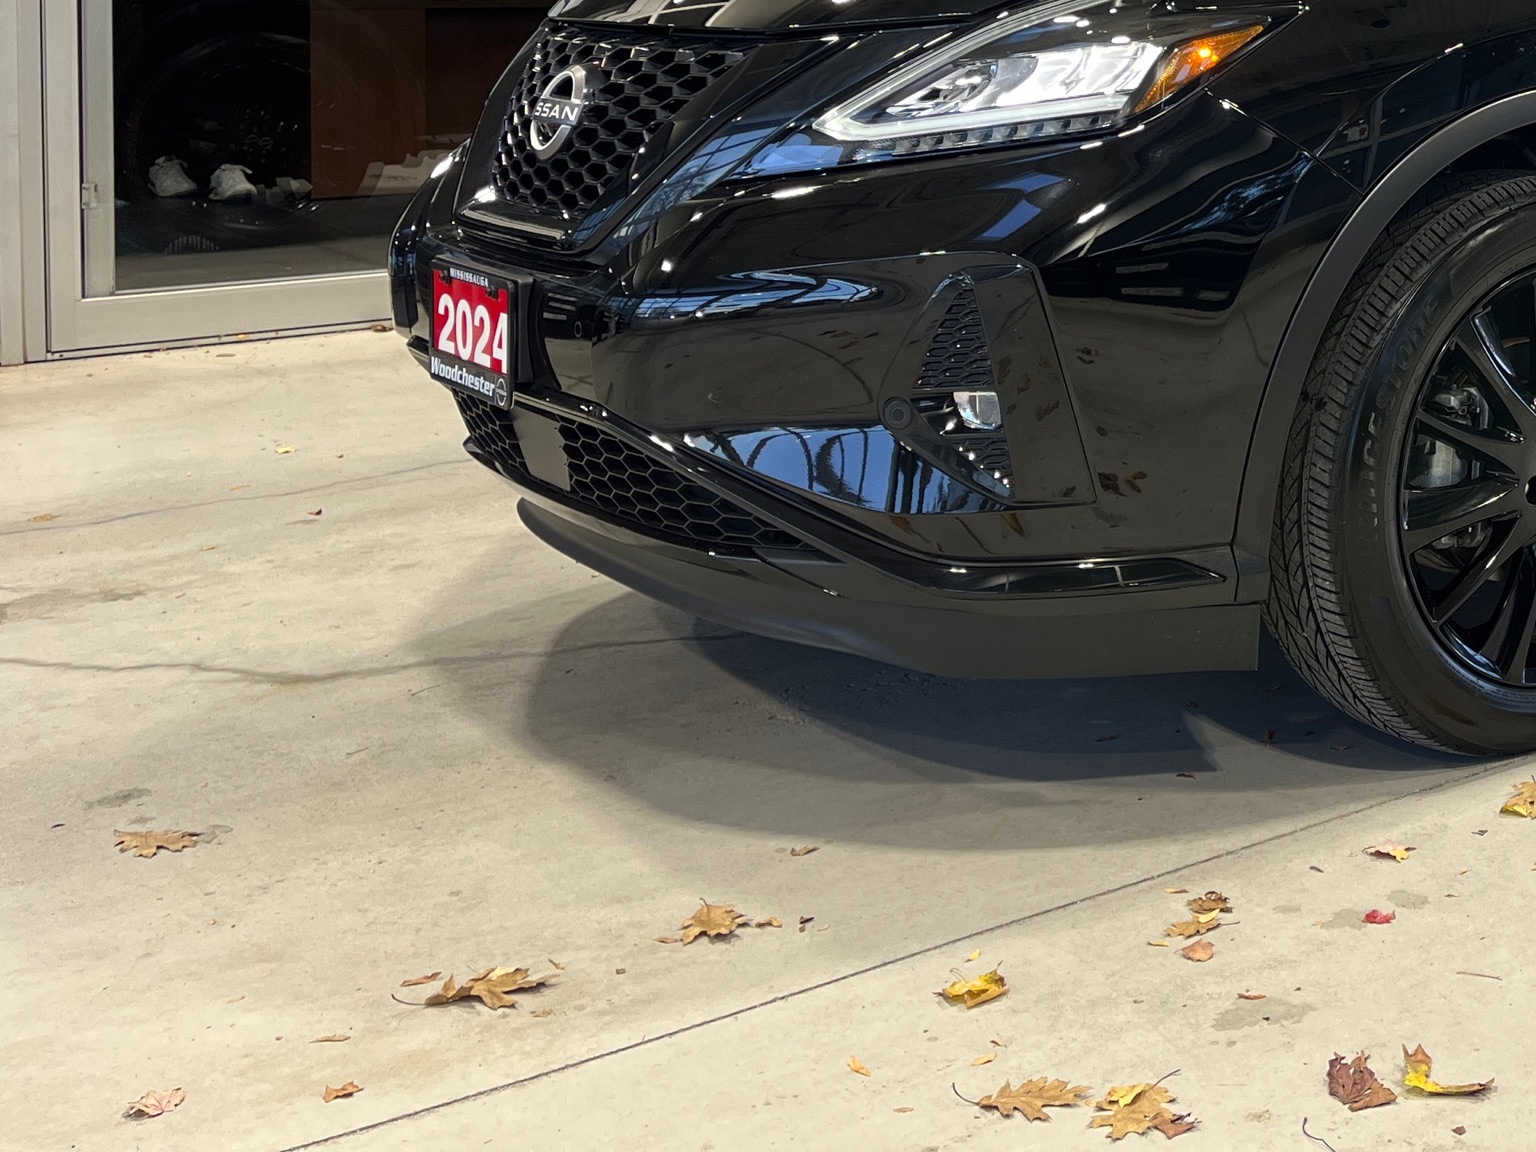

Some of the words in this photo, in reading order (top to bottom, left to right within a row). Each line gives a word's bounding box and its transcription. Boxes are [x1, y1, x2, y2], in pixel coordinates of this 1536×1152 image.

[534, 102, 579, 121] SSAN
[449, 267, 489, 287] MISSISSAUGA
[437, 293, 508, 374] 2024
[430, 356, 495, 397] Woodchester
